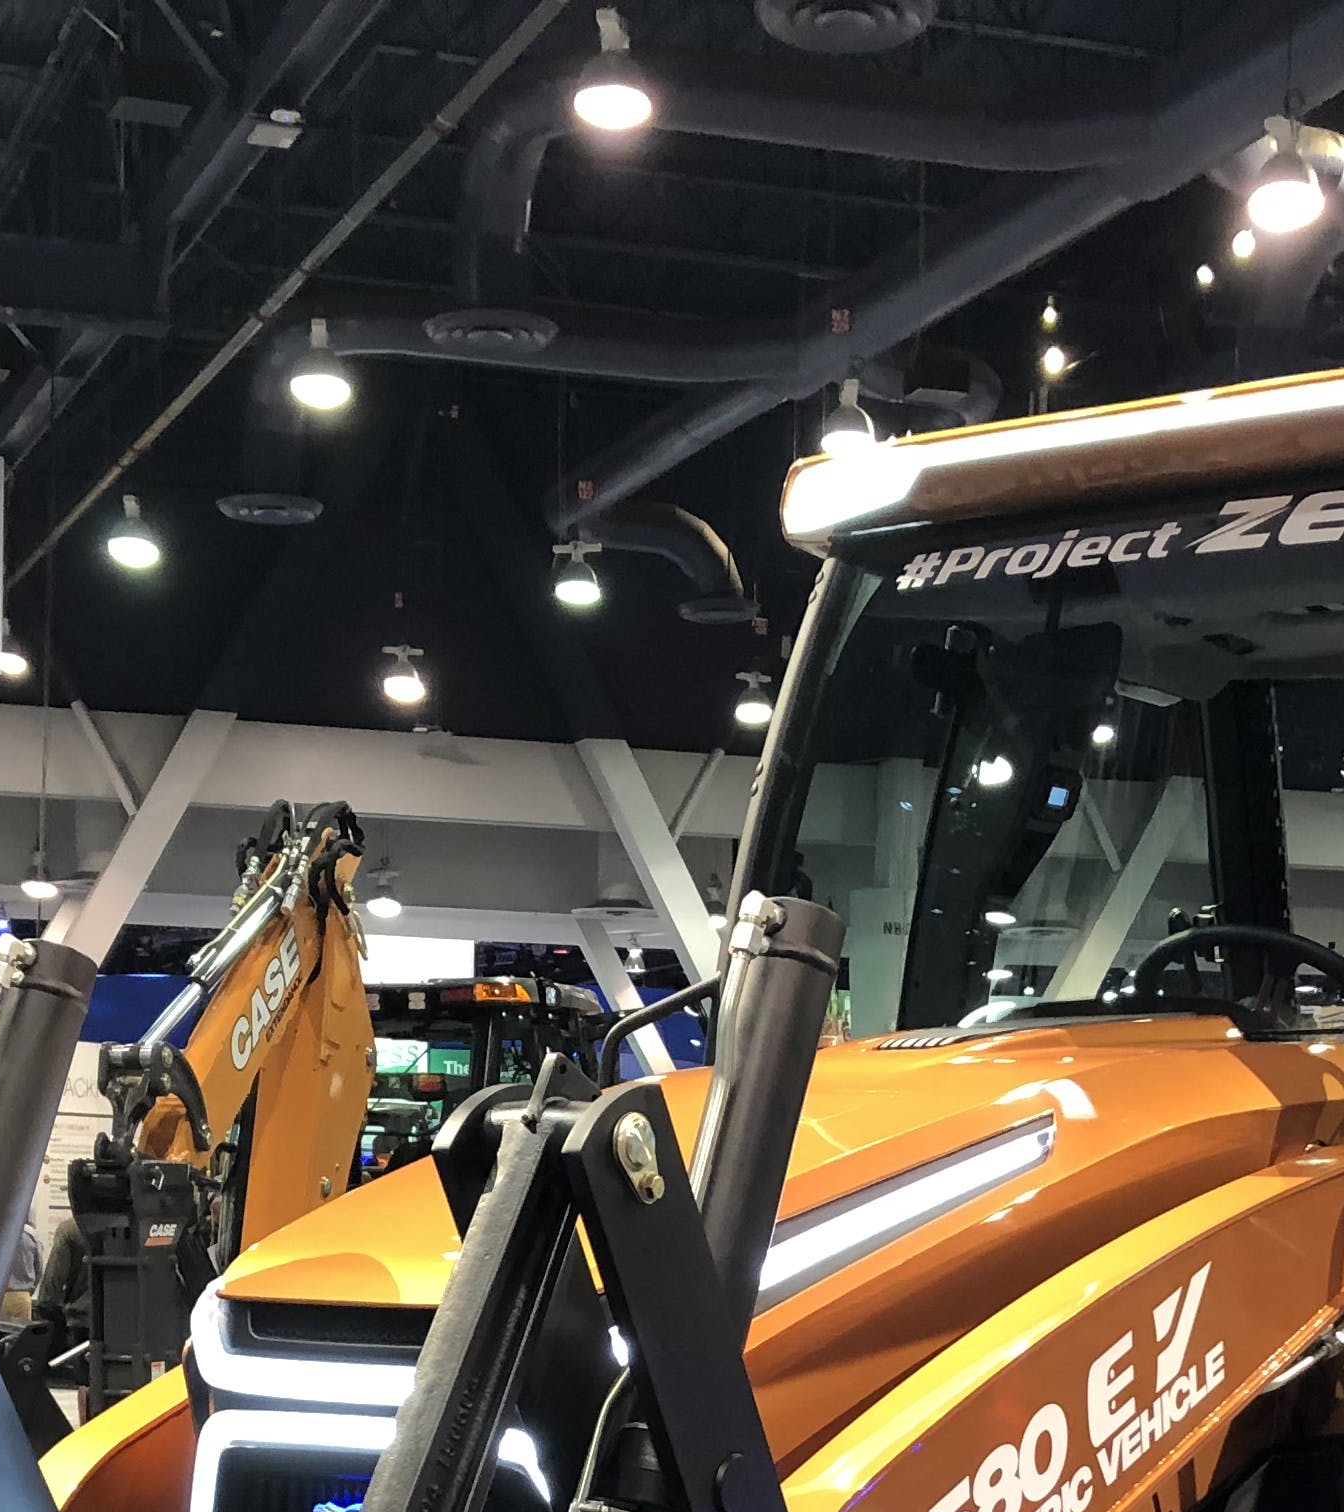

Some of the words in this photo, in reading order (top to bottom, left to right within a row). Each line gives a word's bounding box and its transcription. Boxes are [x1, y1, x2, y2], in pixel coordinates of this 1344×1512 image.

[894, 520, 1183, 592] #Project
[230, 926, 301, 1072] CASE
[149, 1223, 177, 1238] CASE
[1095, 1340, 1226, 1487] VEHICLE
